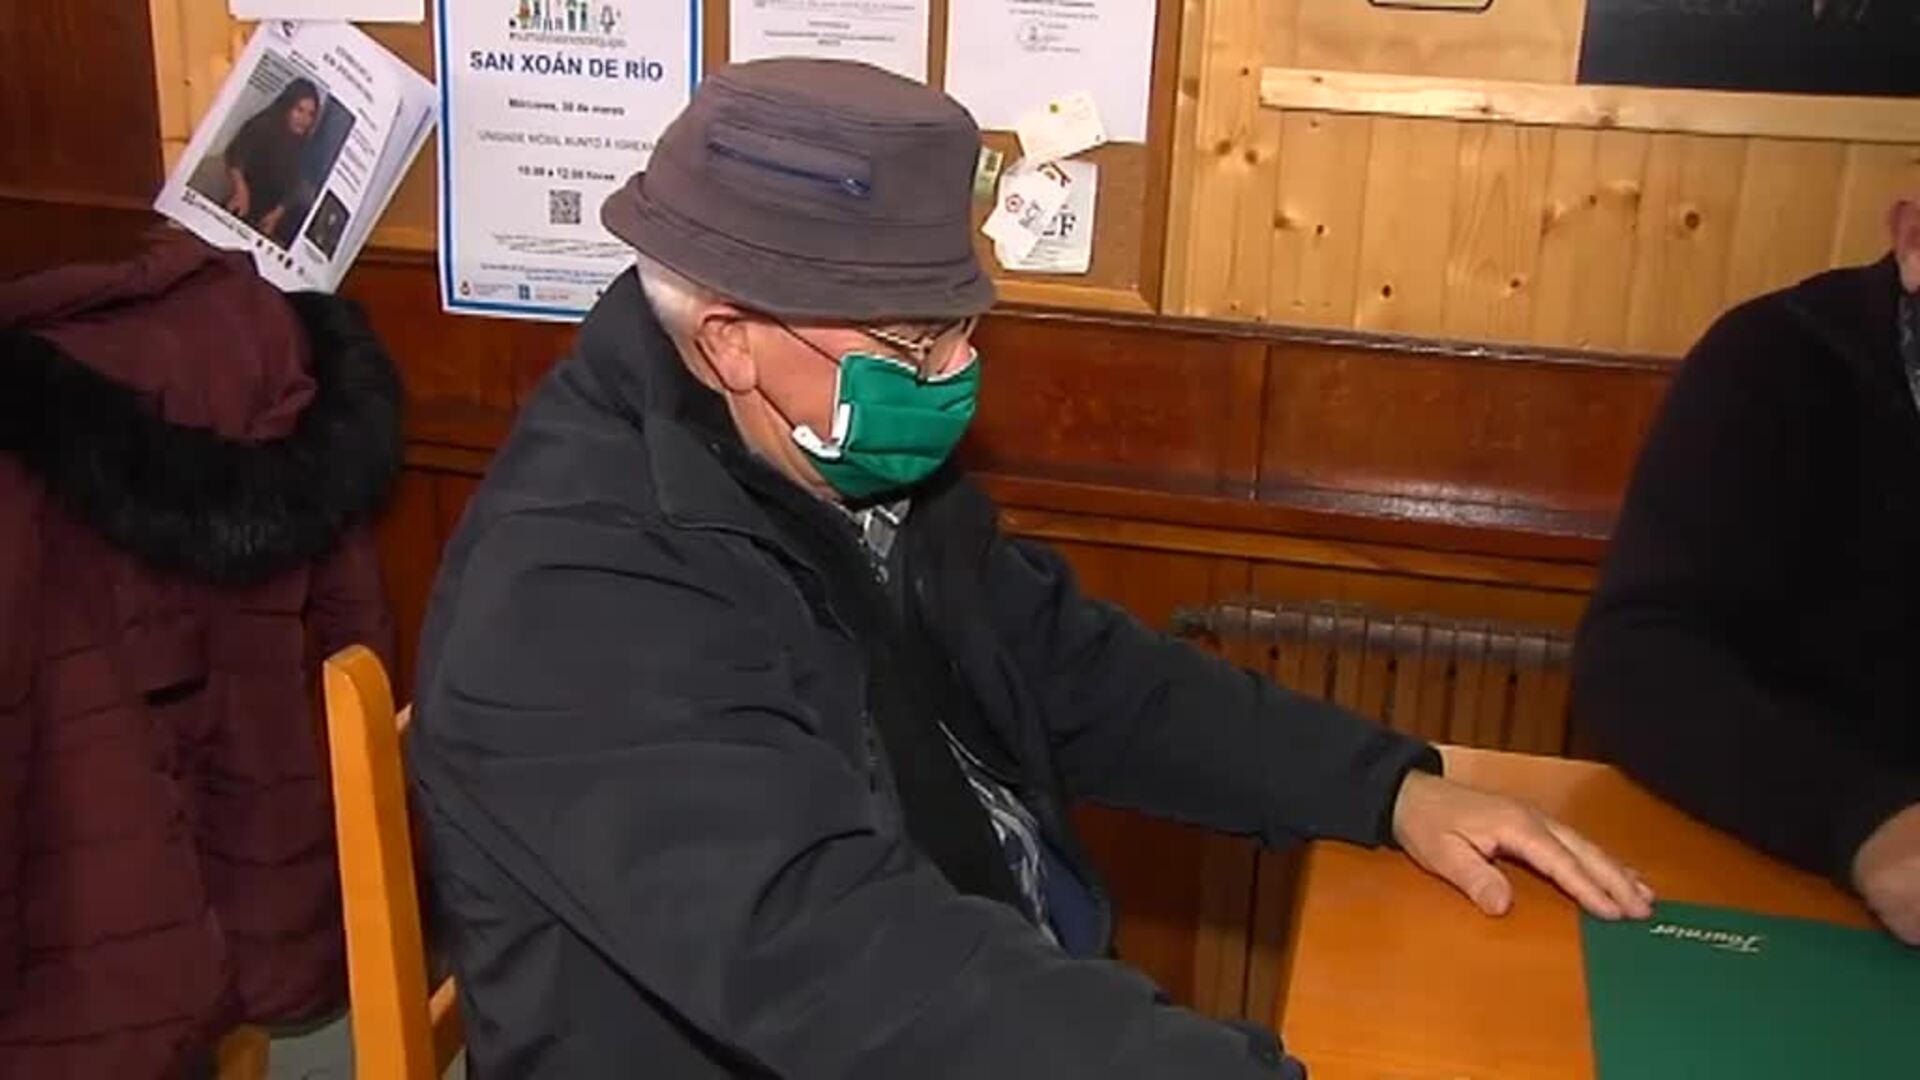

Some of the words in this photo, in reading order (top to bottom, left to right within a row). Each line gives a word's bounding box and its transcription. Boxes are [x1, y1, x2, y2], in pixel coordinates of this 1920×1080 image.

[470, 51, 514, 72] SAN
[521, 53, 582, 75] XOÁN
[589, 58, 618, 79] DE
[625, 58, 664, 81] RÍO
[577, 102, 589, 113] de
[1650, 924, 1760, 952] Fournier
